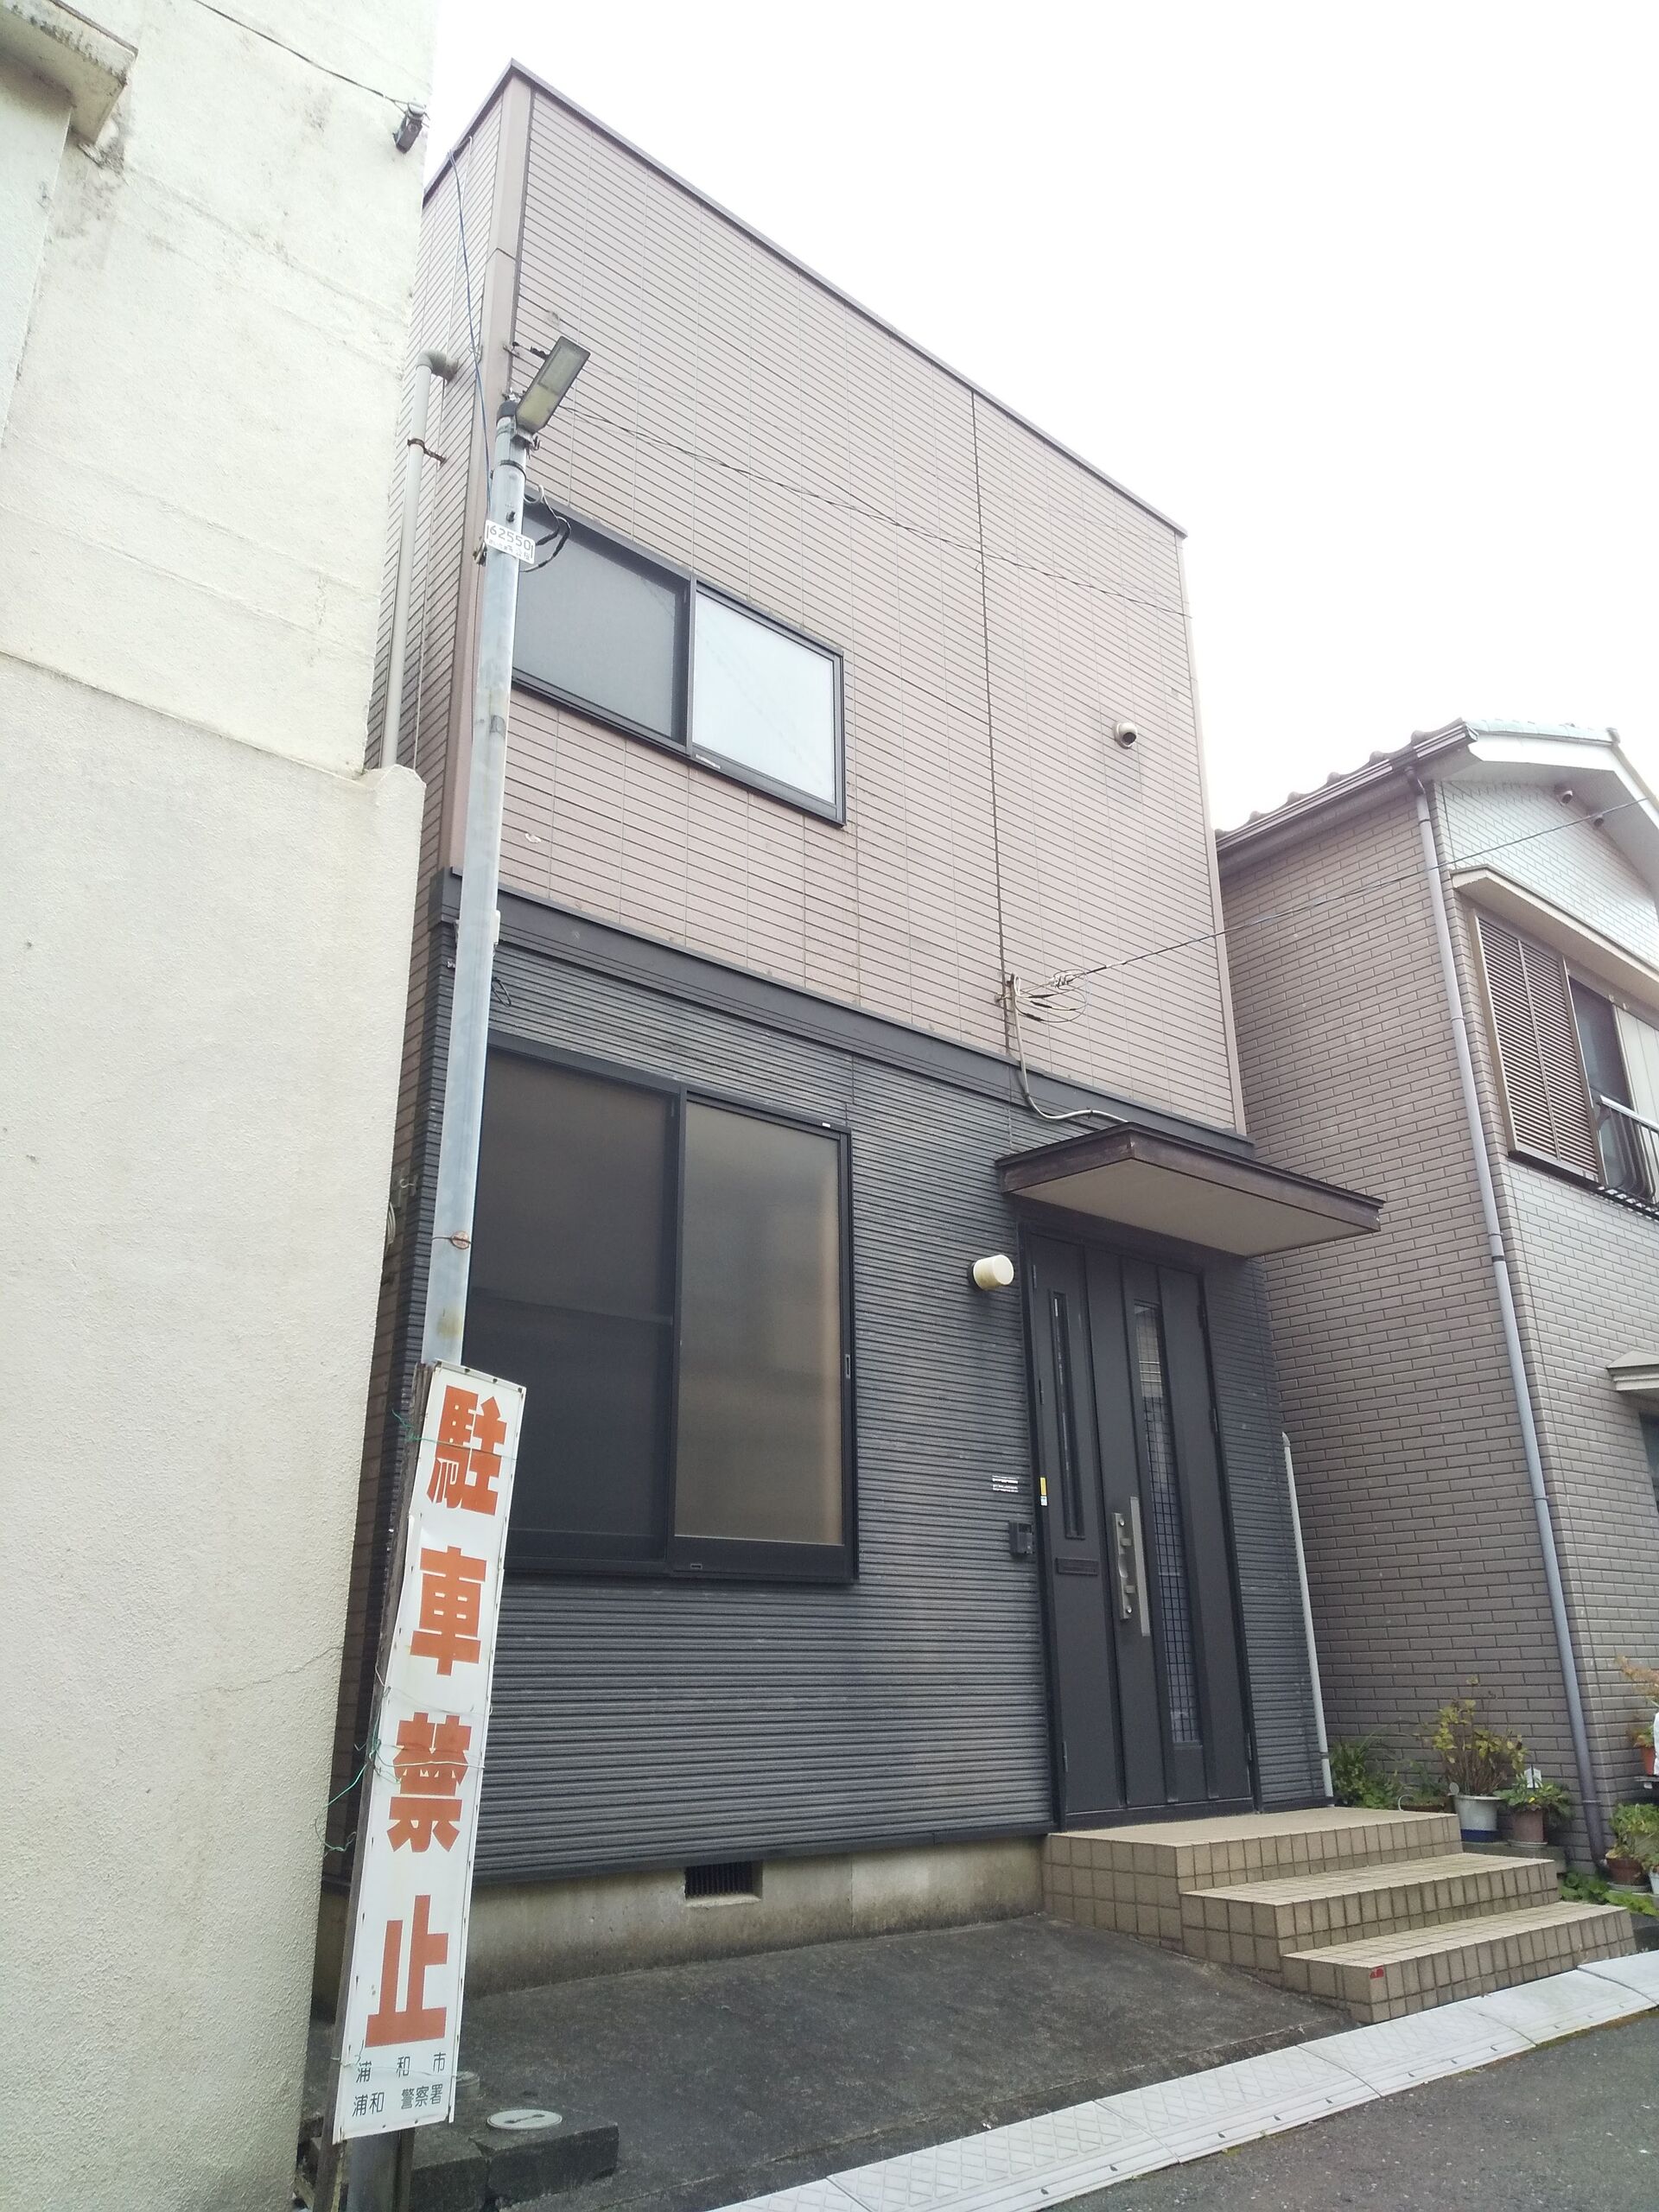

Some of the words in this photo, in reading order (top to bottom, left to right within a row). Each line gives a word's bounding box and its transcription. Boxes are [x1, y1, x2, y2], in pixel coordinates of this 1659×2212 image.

[489, 524, 531, 550] 62550
[365, 1384, 507, 2048] 駐車禁止
[355, 2051, 447, 2083] 浦和市
